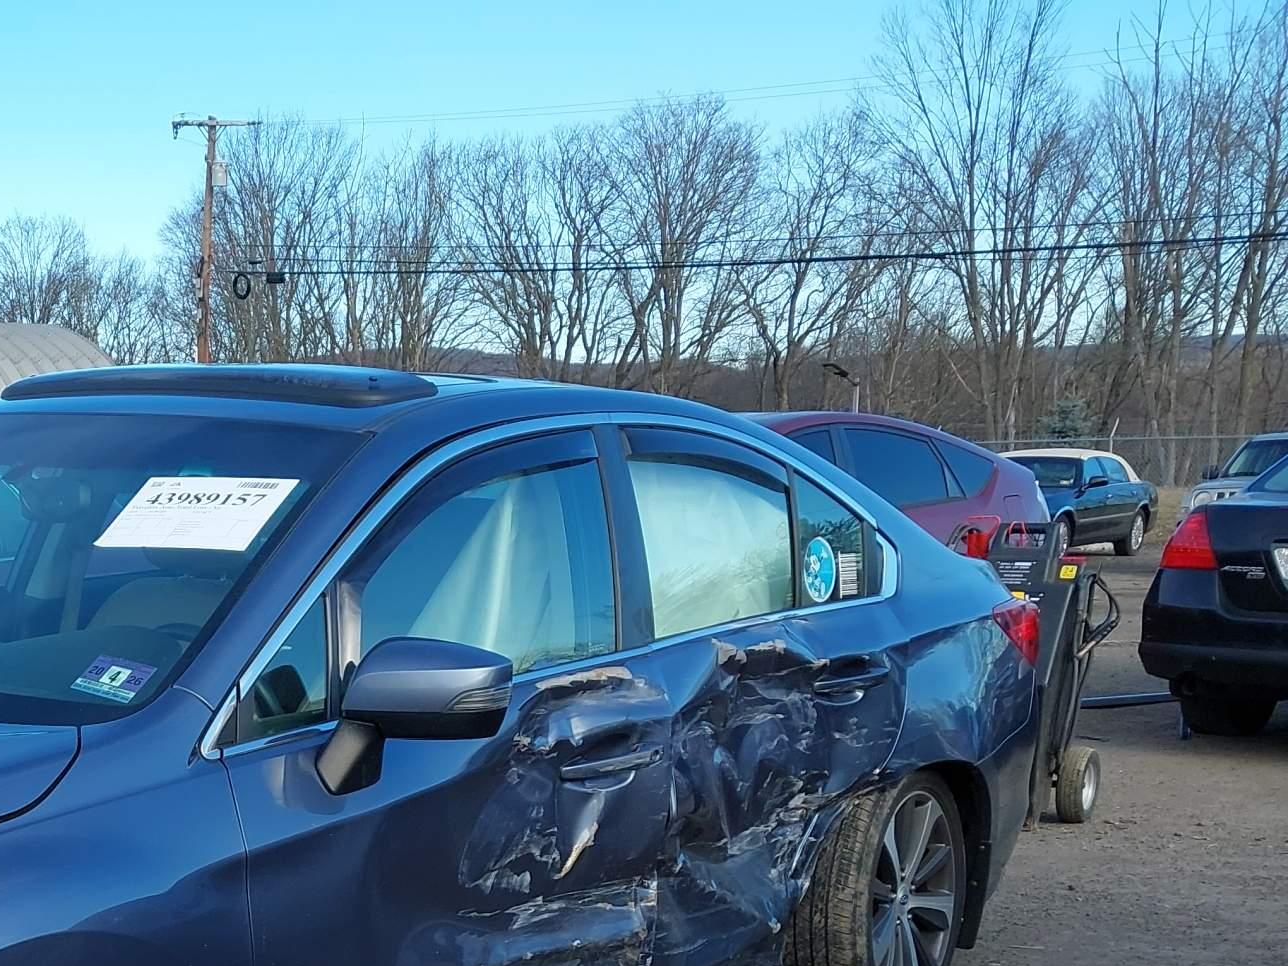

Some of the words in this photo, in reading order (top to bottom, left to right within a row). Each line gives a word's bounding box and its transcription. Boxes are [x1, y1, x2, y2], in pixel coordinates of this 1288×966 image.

[145, 492, 268, 507] 43989157
[88, 666, 105, 675] 20
[109, 671, 122, 683] 4
[126, 676, 144, 686] 26
